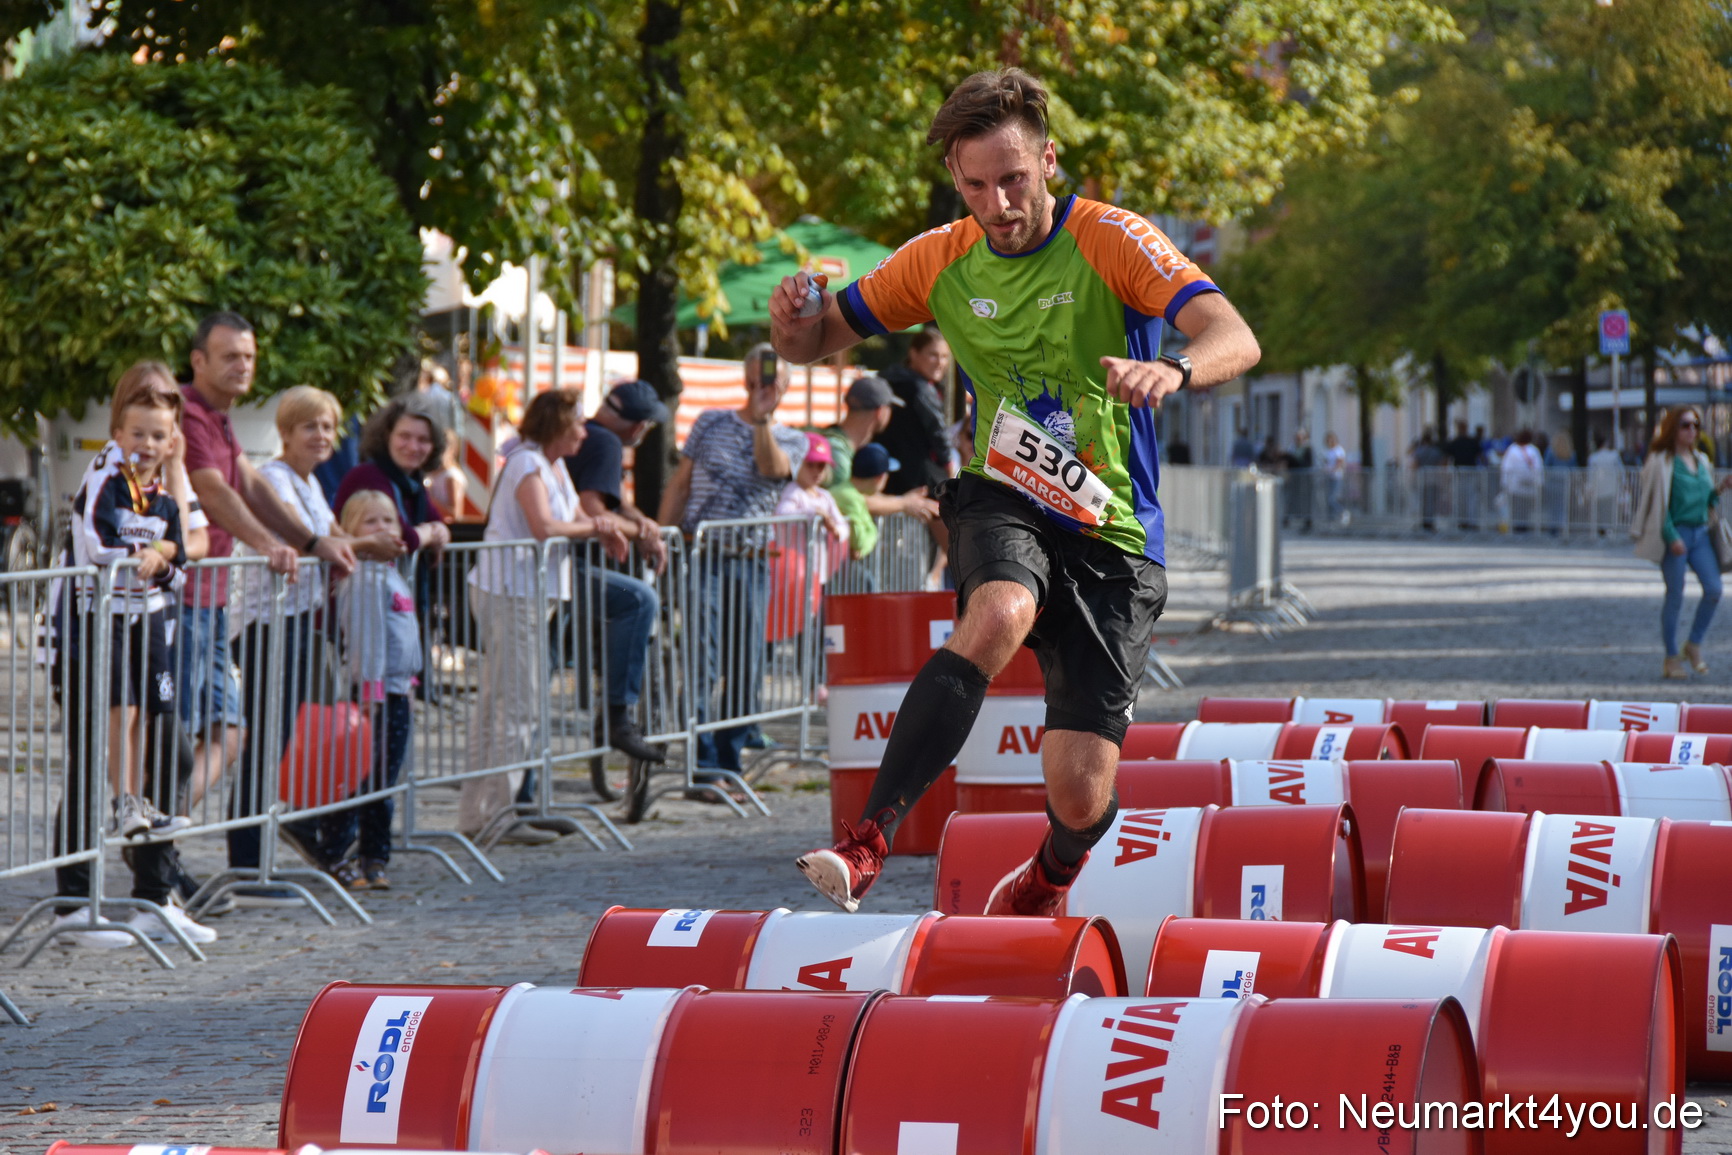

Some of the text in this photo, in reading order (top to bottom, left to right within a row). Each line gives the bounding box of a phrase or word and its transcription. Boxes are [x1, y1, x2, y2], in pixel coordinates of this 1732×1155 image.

[1098, 207, 1190, 282] BOCK
[1015, 429, 1088, 493] 530
[1012, 465, 1073, 511] MARCO
[854, 712, 897, 741] AV
[997, 726, 1044, 755] AV
[799, 1107, 814, 1137] 323
